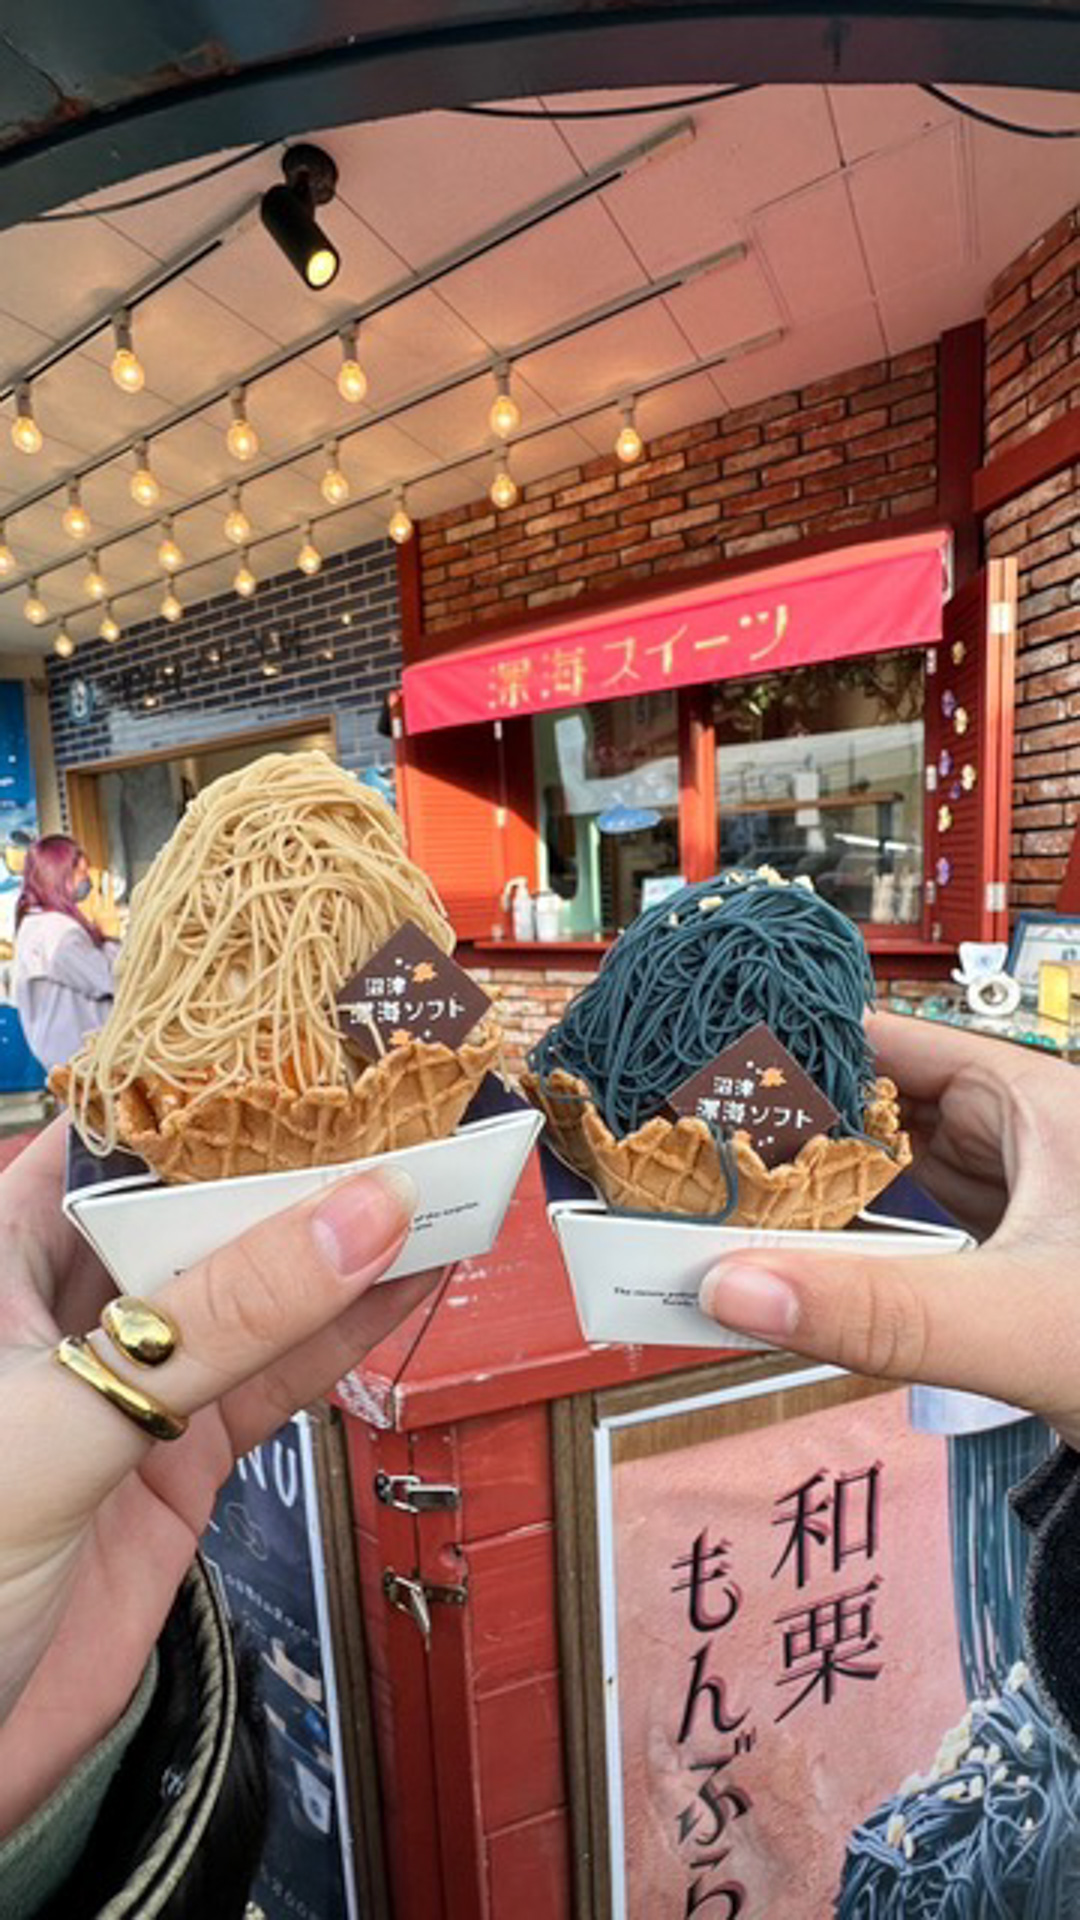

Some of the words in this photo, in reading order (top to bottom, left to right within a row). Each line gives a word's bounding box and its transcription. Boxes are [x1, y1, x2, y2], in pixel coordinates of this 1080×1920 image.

[487, 604, 790, 710] 深海スイーツ
[364, 976, 407, 997] 沼津
[713, 1075, 755, 1097] 沼津
[695, 1097, 813, 1129] 深海ソフト
[770, 1459, 884, 1725] 和栗
